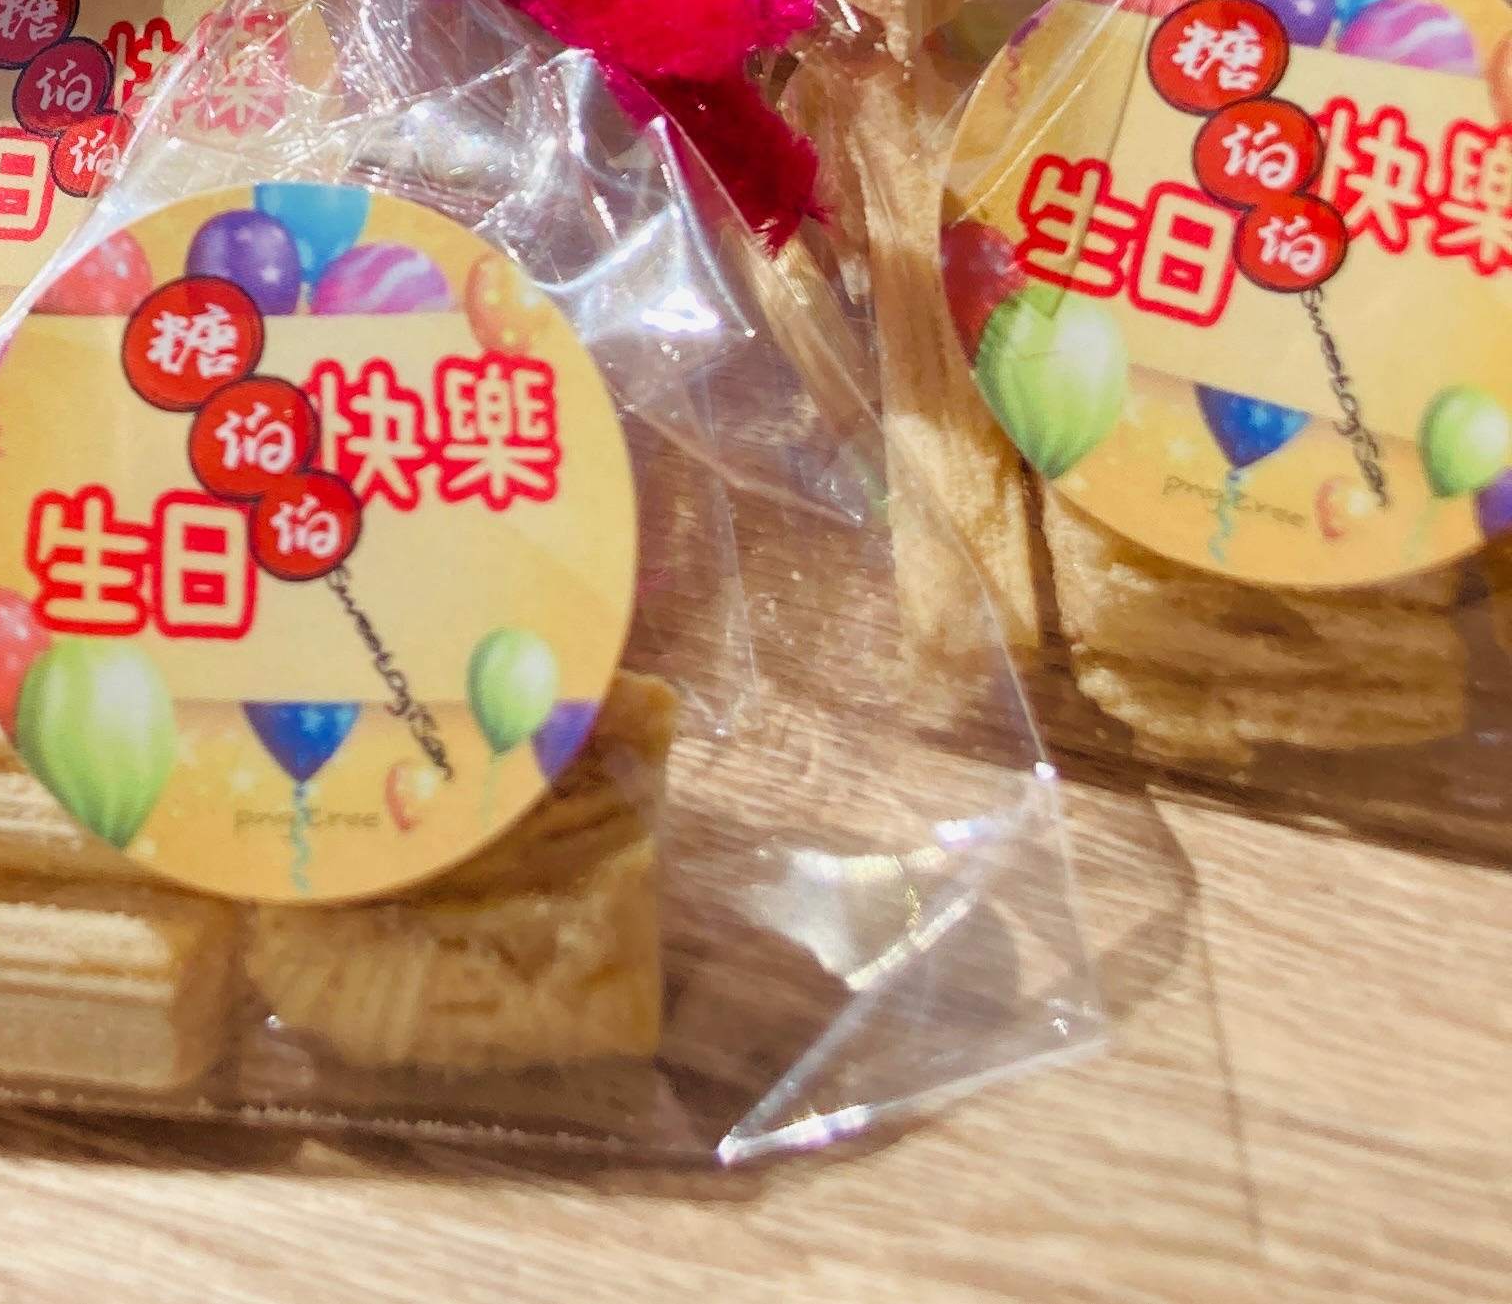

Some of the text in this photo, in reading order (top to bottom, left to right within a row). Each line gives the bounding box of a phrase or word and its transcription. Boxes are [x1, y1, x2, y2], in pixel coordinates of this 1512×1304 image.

[1016, 153, 1249, 328] 生日
[1172, 21, 1325, 275] 糖伯伯
[25, 353, 563, 640] 生日 快樂
[146, 301, 339, 558] 糖伯伯
